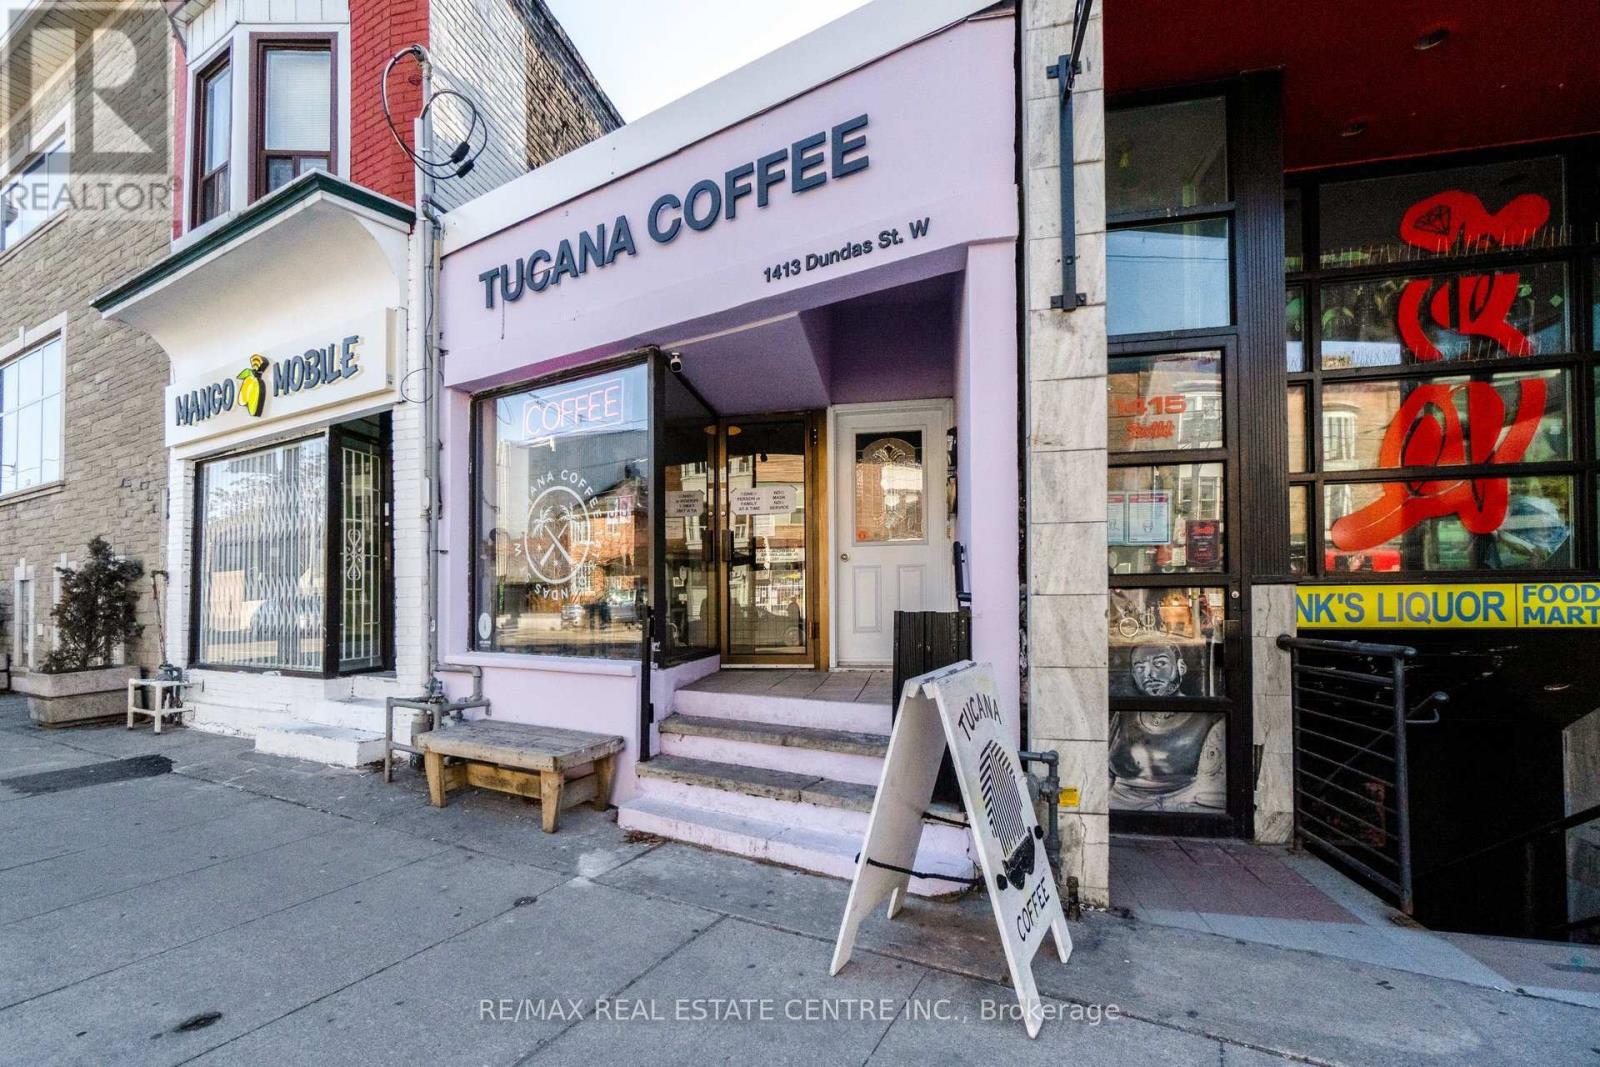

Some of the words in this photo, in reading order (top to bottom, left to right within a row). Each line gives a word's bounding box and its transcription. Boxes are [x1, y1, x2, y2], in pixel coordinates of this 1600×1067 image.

[479, 215, 636, 308] TUCANA
[647, 113, 869, 243] COFFEE
[763, 258, 801, 283] 1413
[806, 241, 873, 271] Dundas
[878, 228, 904, 249] St.
[909, 217, 930, 239] W
[175, 378, 235, 426] MANGO
[272, 335, 359, 397] MOBILE
[525, 385, 620, 436] COFFEE
[560, 469, 603, 518] COFFEE
[1378, 591, 1506, 624] LIQUOR
[1522, 584, 1600, 603] FOOD
[1523, 605, 1600, 625] MART
[958, 692, 1002, 742] TUCANA
[1016, 877, 1050, 942] COFFEE
